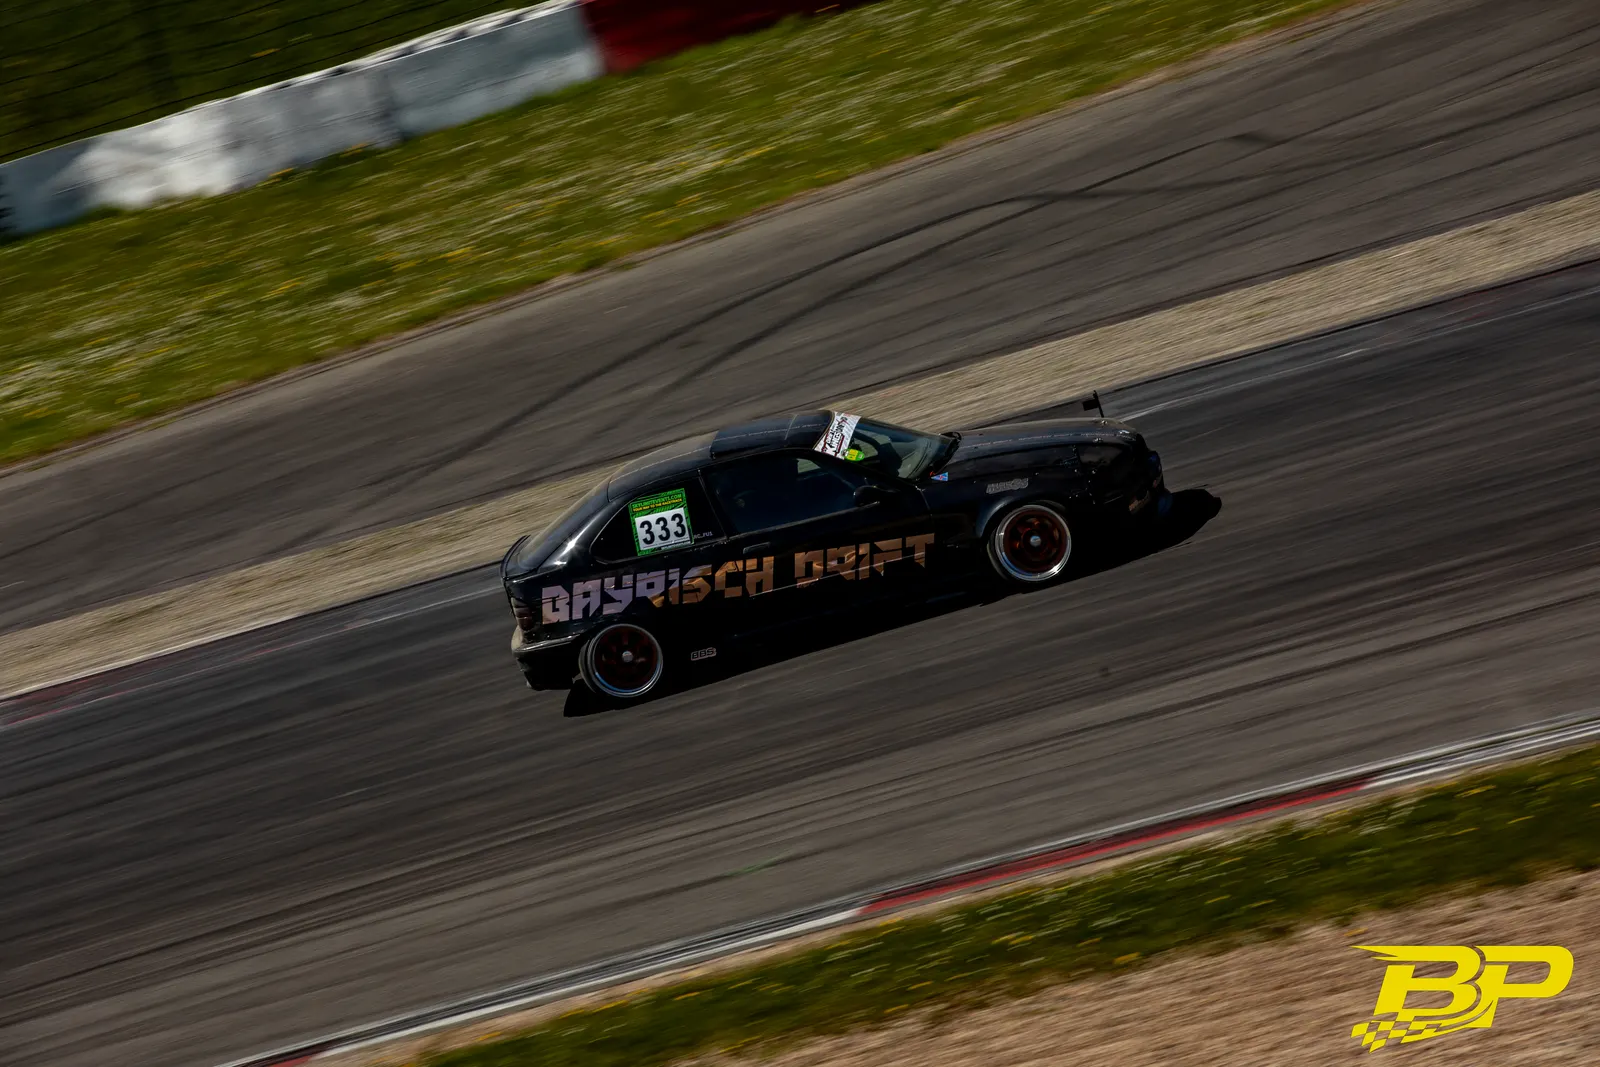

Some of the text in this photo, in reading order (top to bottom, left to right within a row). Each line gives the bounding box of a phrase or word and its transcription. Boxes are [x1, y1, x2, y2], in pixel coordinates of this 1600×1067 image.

[640, 513, 686, 545] 333
[542, 533, 935, 625] BAYRISCH DRIFT
[691, 647, 716, 661] BBS
